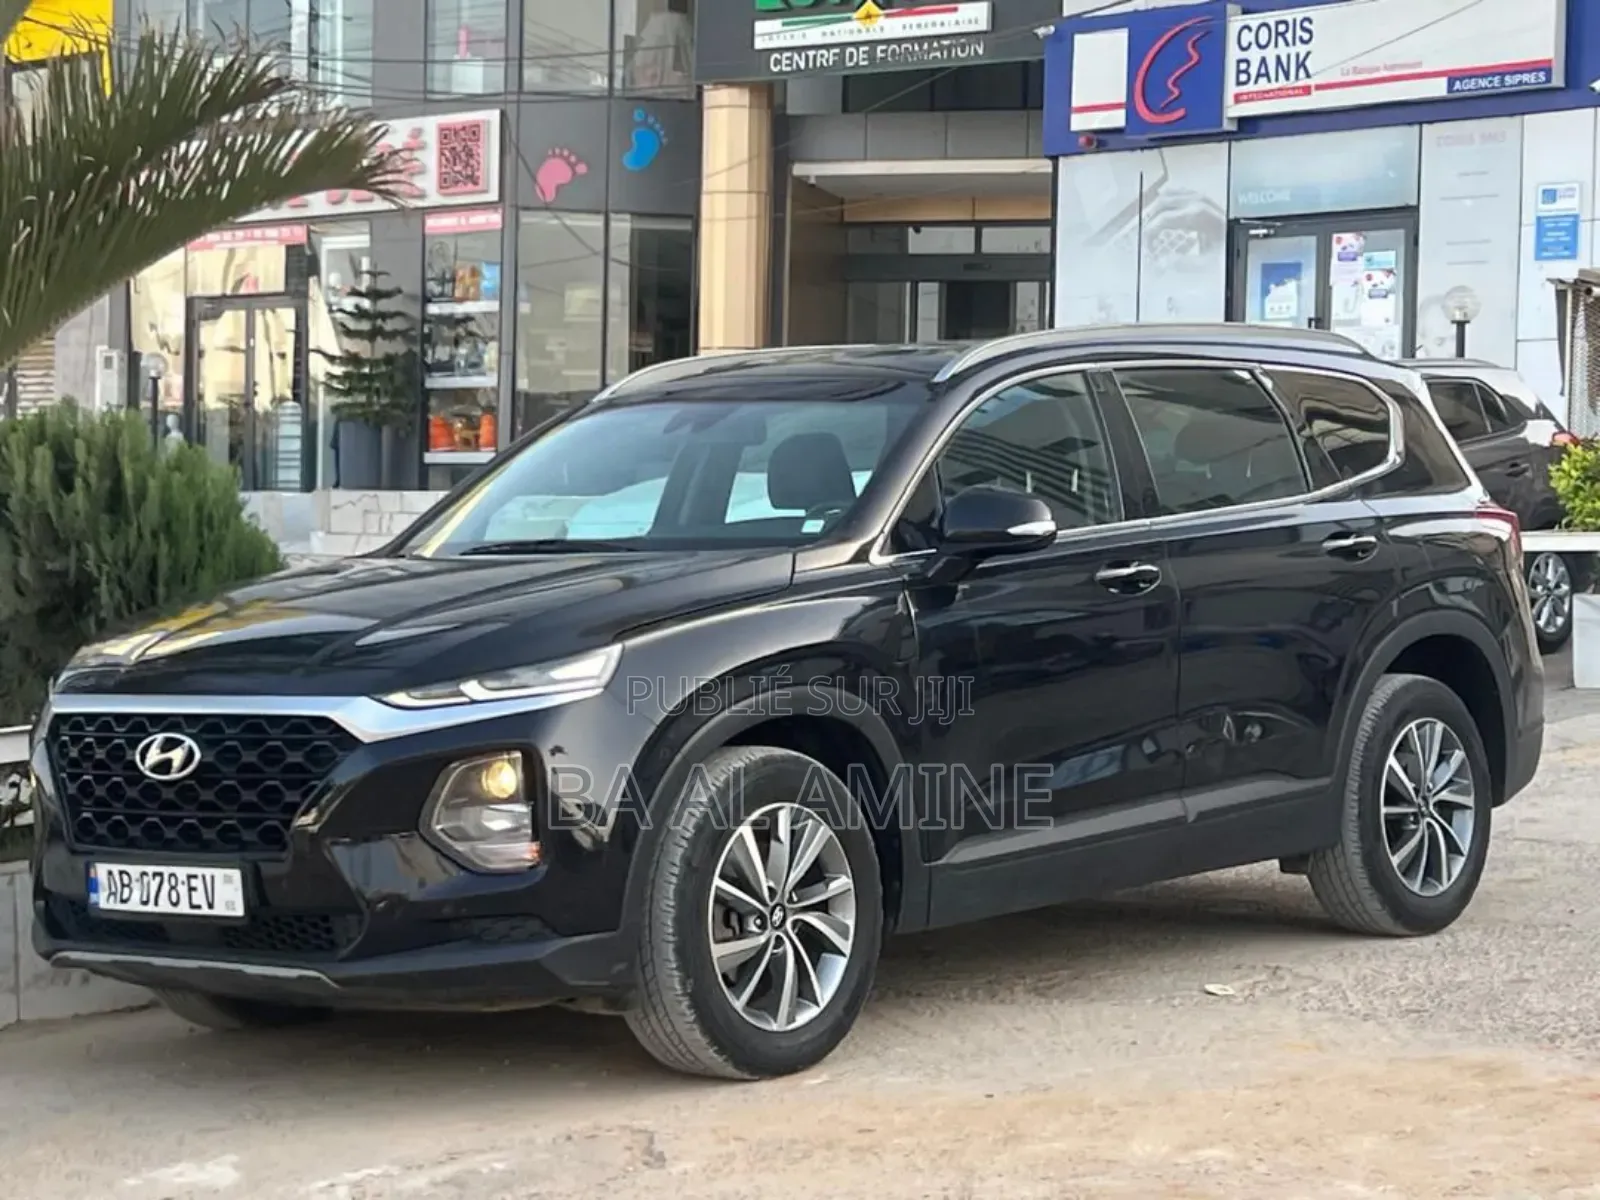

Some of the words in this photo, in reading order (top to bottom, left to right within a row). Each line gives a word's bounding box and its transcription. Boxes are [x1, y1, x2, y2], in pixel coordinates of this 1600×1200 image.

[1236, 16, 1314, 52] CORIS
[845, 46, 869, 66] DE
[876, 40, 985, 63] FORMATION
[1235, 51, 1312, 87] BANK
[1453, 75, 1501, 91] AGENCE
[1504, 71, 1546, 88] SIPRES
